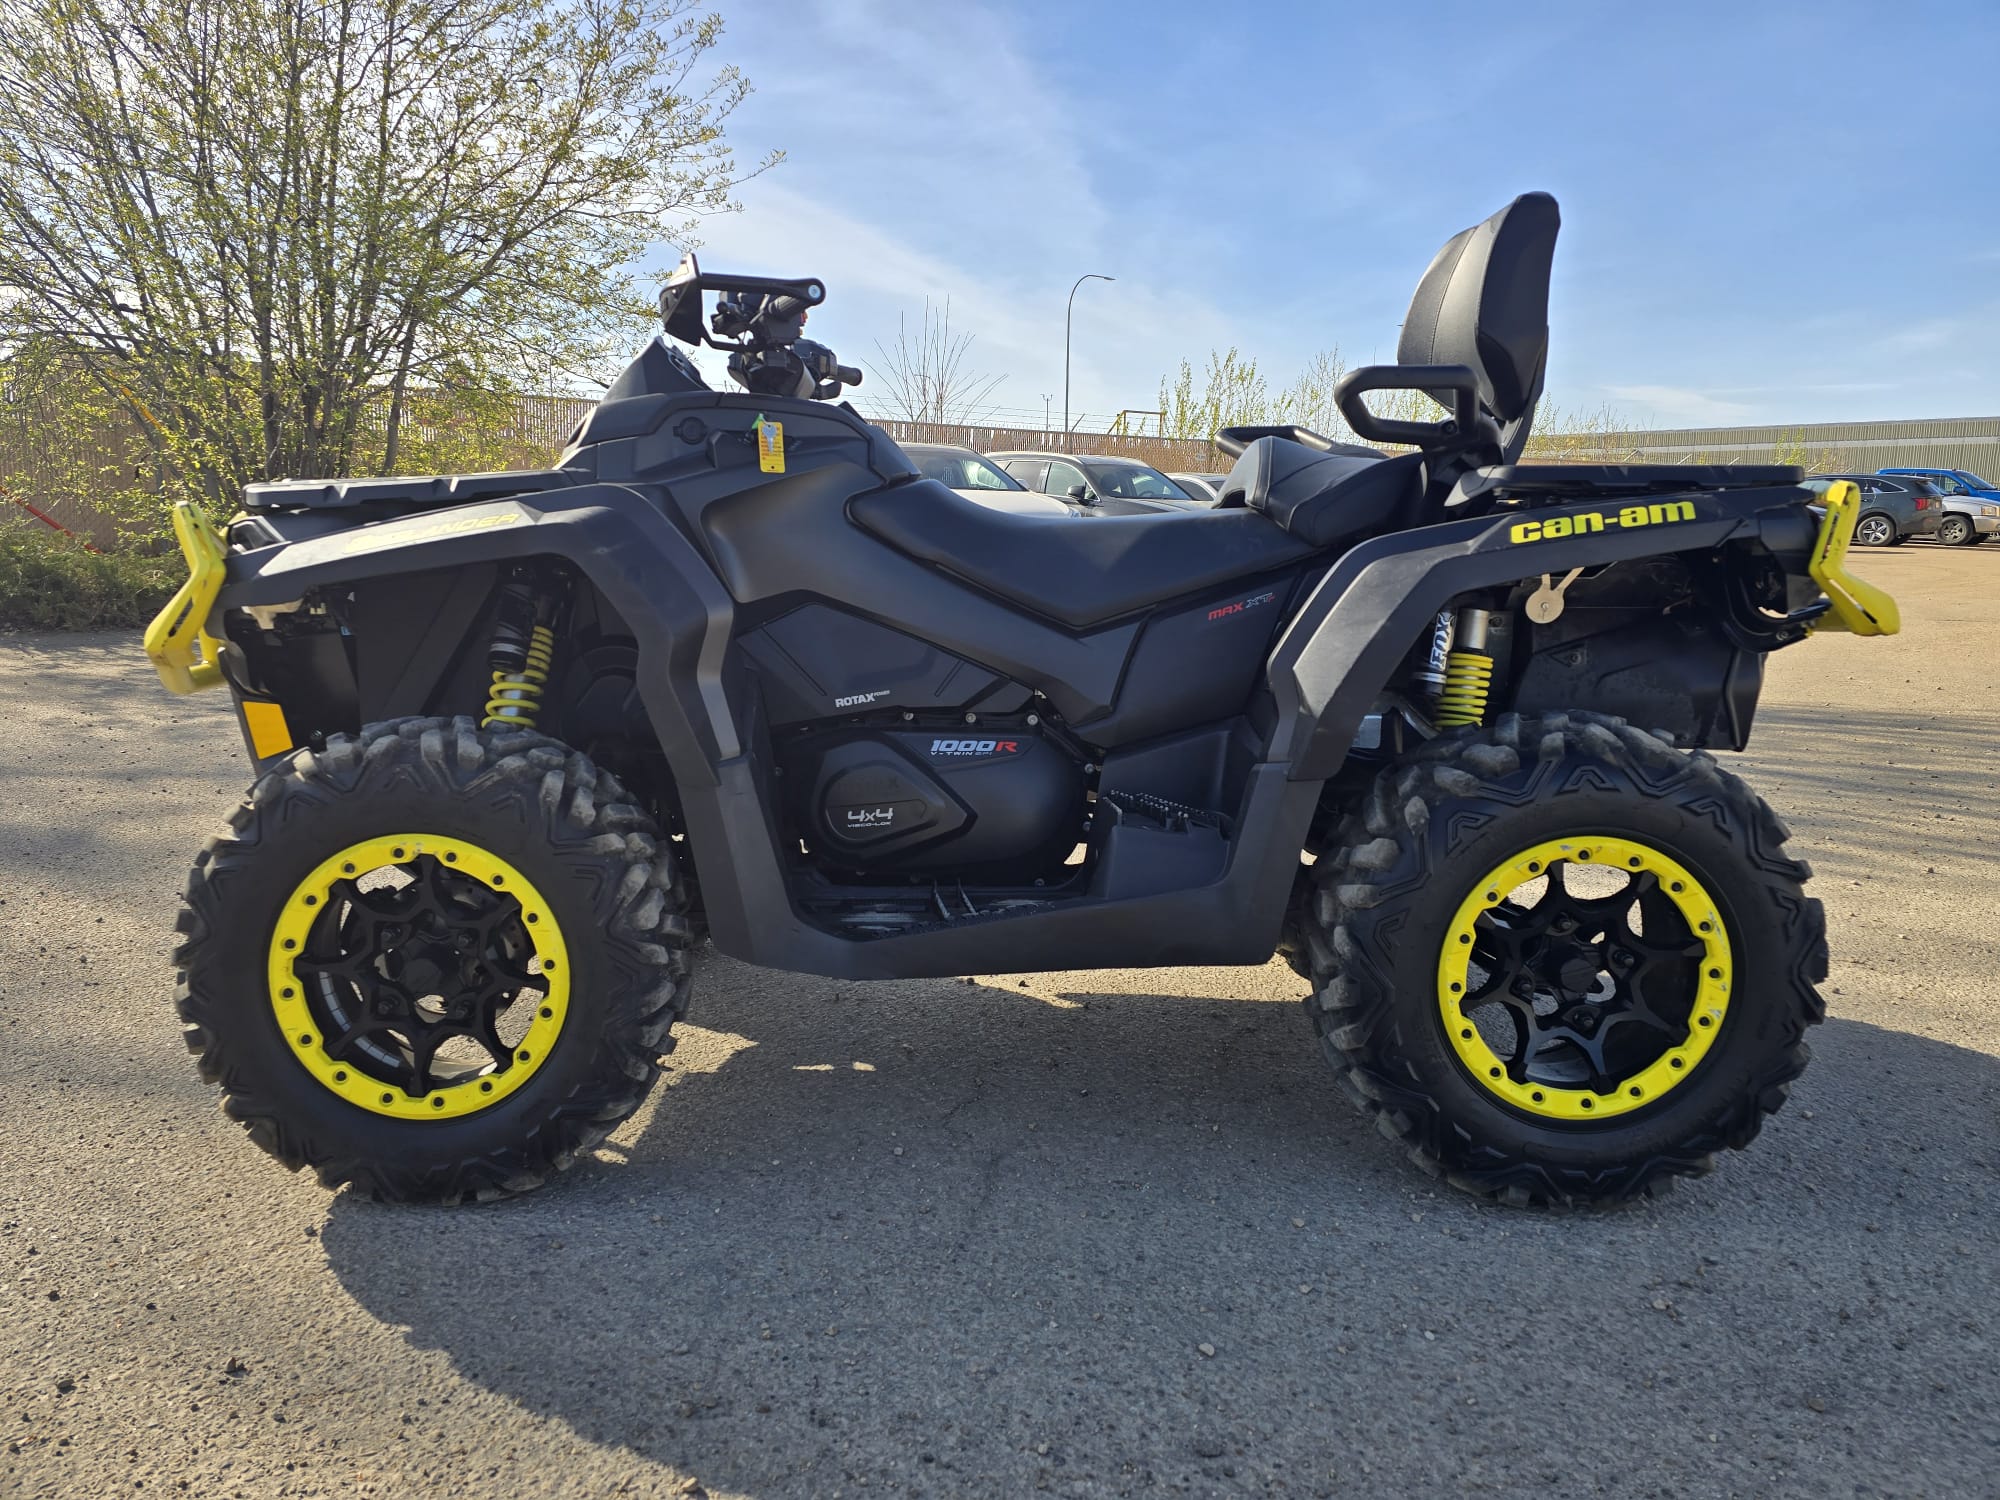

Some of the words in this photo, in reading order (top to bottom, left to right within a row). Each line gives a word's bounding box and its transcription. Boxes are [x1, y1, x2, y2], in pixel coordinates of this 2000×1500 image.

[1510, 500, 1697, 544] can-am
[1207, 602, 1244, 621] MAX
[835, 692, 876, 708] ROTAX
[930, 739, 1018, 753] 1000R
[847, 807, 894, 822] 4x4
